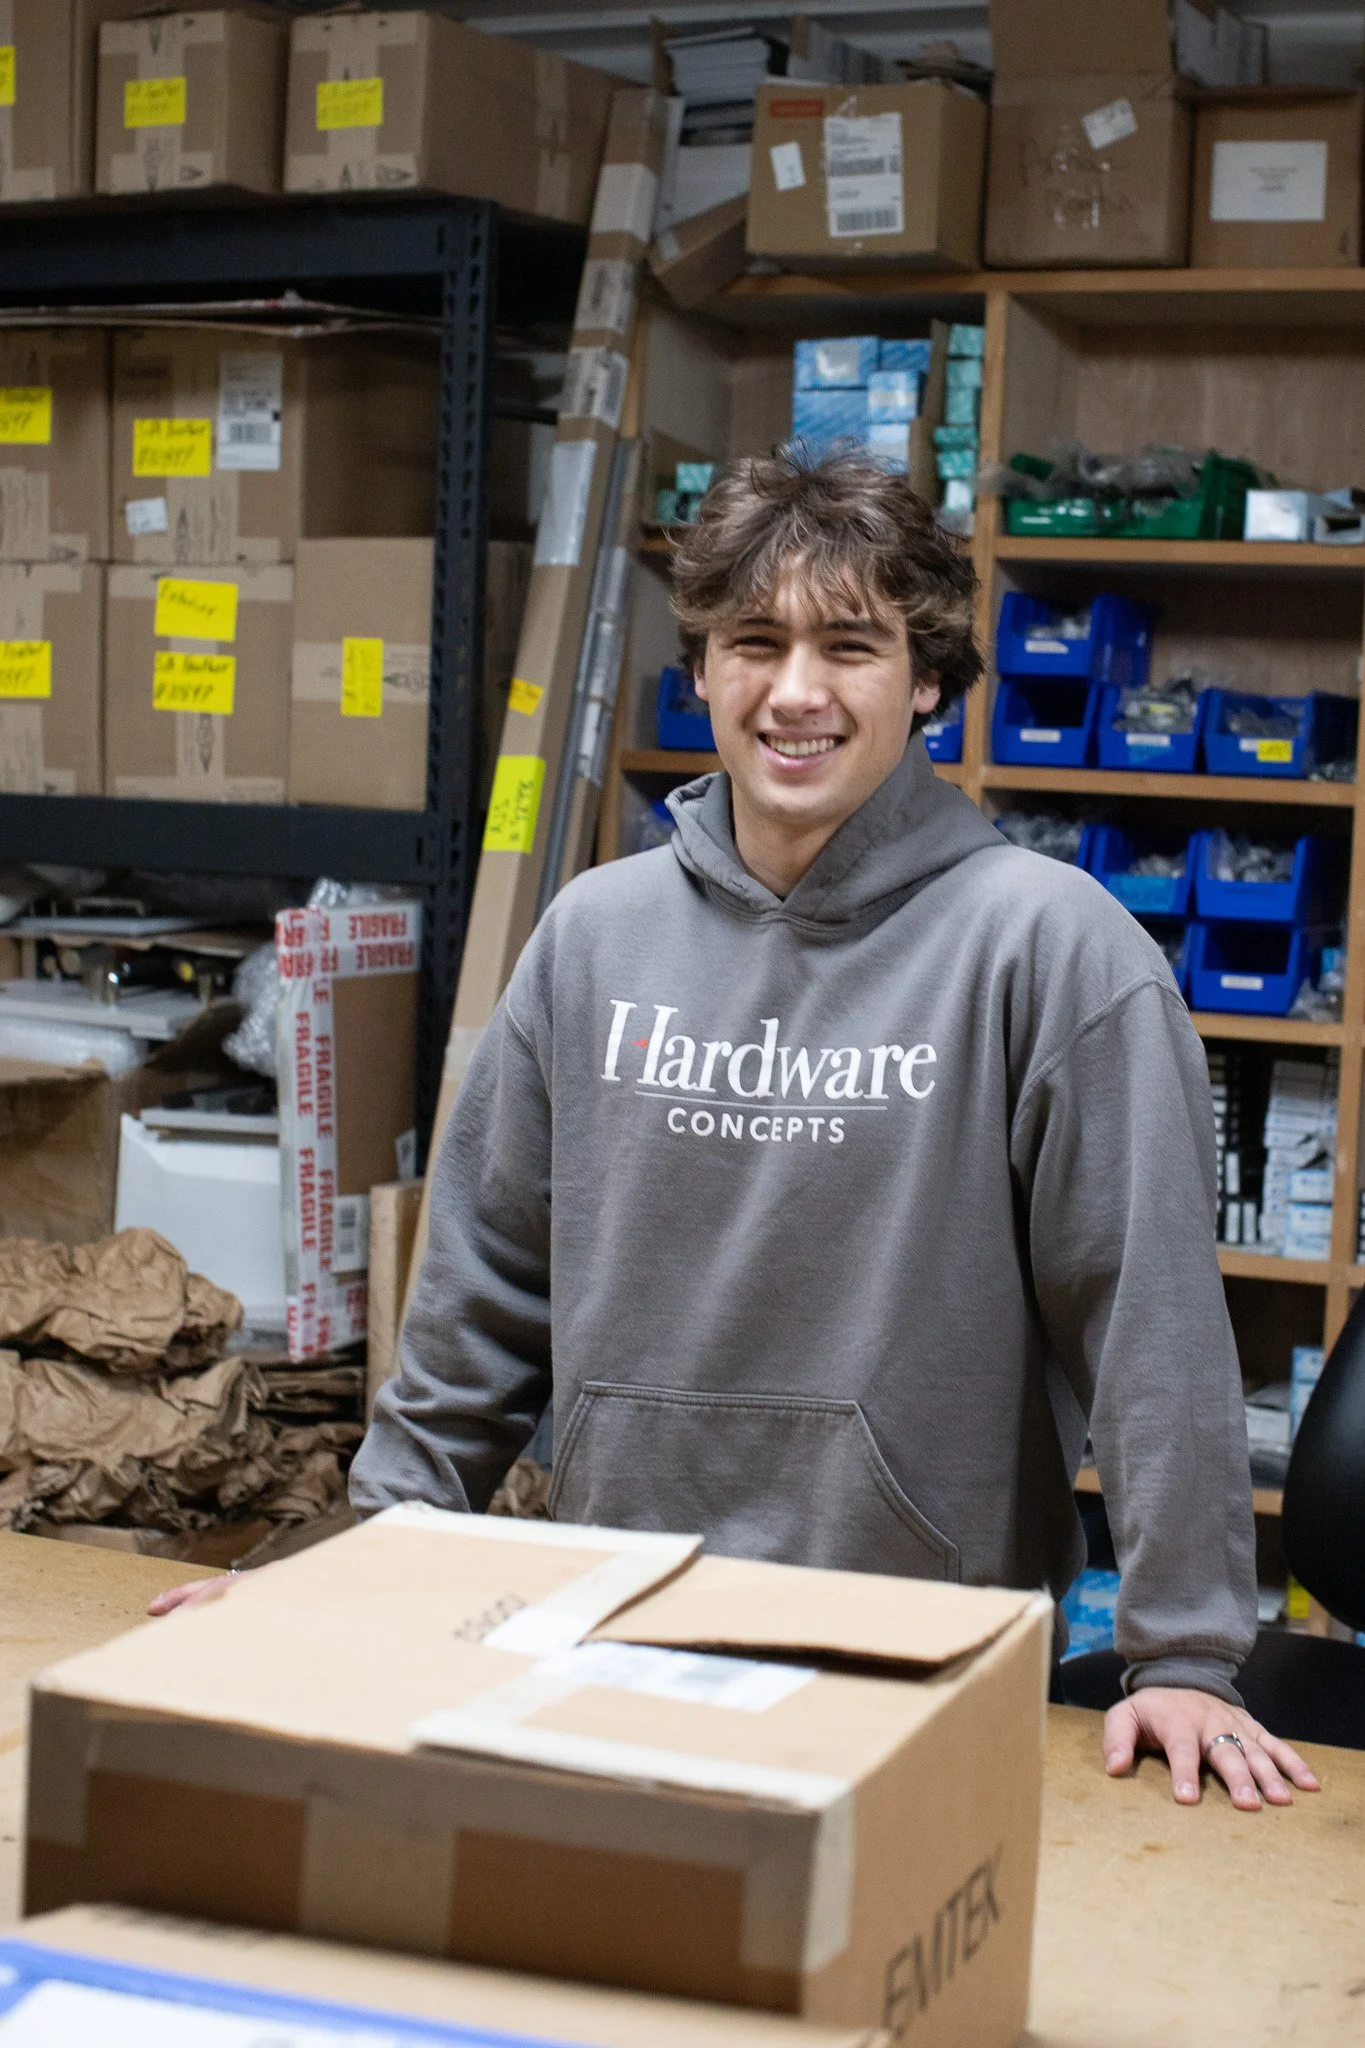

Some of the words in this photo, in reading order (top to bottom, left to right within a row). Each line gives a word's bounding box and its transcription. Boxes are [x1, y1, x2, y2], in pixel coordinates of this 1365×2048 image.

[295, 1012, 314, 1117] FRAGILE
[316, 1035, 334, 1139] FRAGILE
[600, 999, 937, 1100] Hardware
[667, 1107, 845, 1144] CONCEPTS
[299, 1147, 316, 1252] FRAGILE
[318, 1168, 334, 1271] FRAGILE
[881, 1842, 1005, 2040] EMTEK
